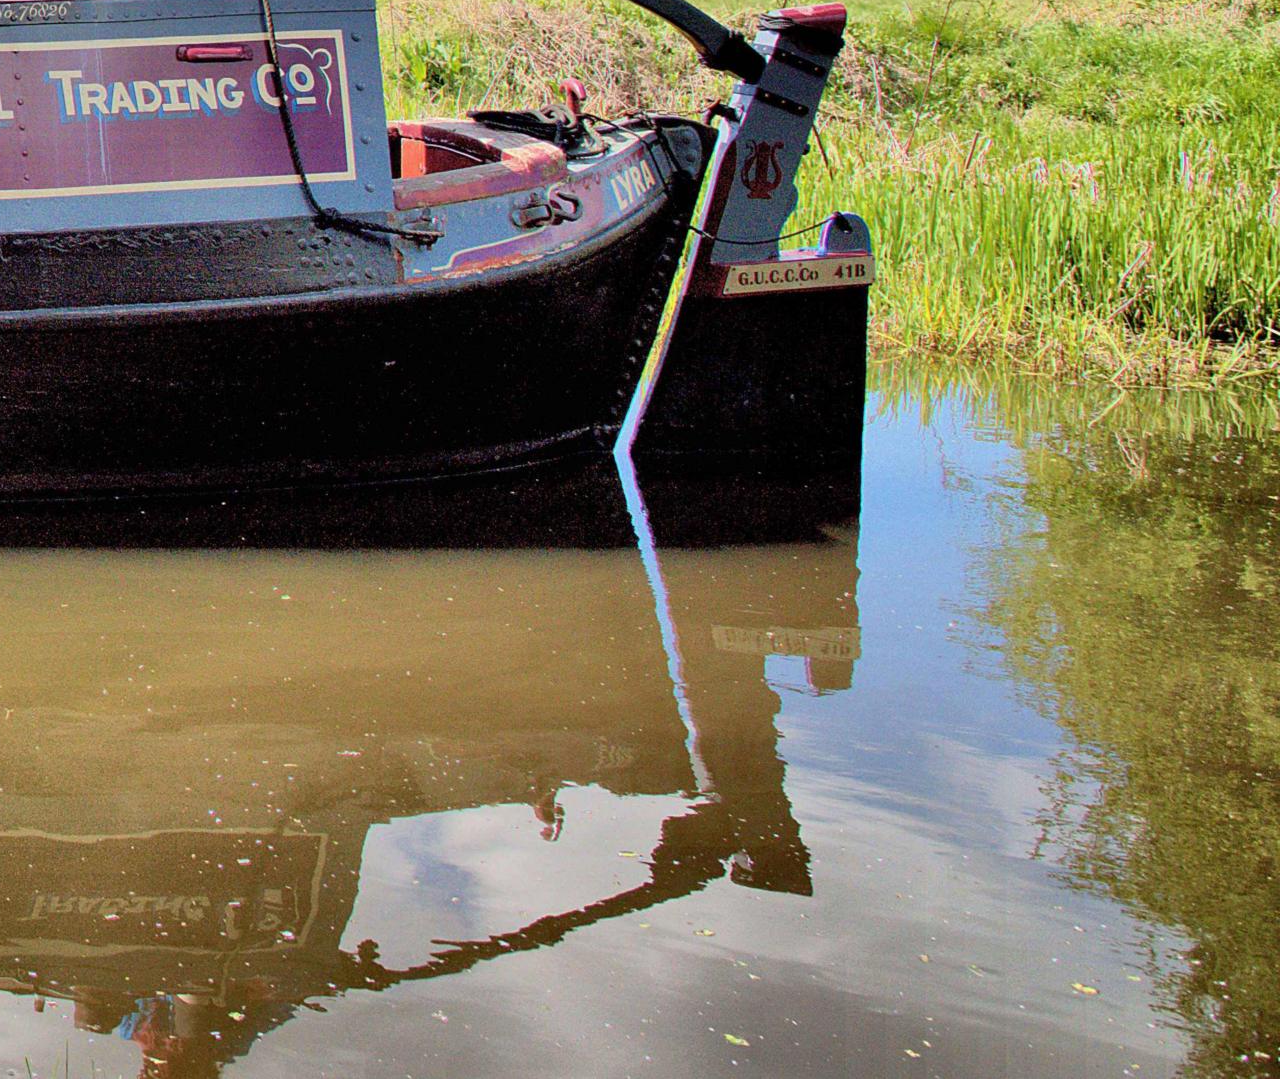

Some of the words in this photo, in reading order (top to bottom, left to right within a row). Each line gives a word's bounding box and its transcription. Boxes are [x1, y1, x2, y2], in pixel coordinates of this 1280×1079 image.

[47, 69, 245, 117] TRADING
[610, 159, 657, 211] LYRA
[834, 263, 866, 279] 41B
